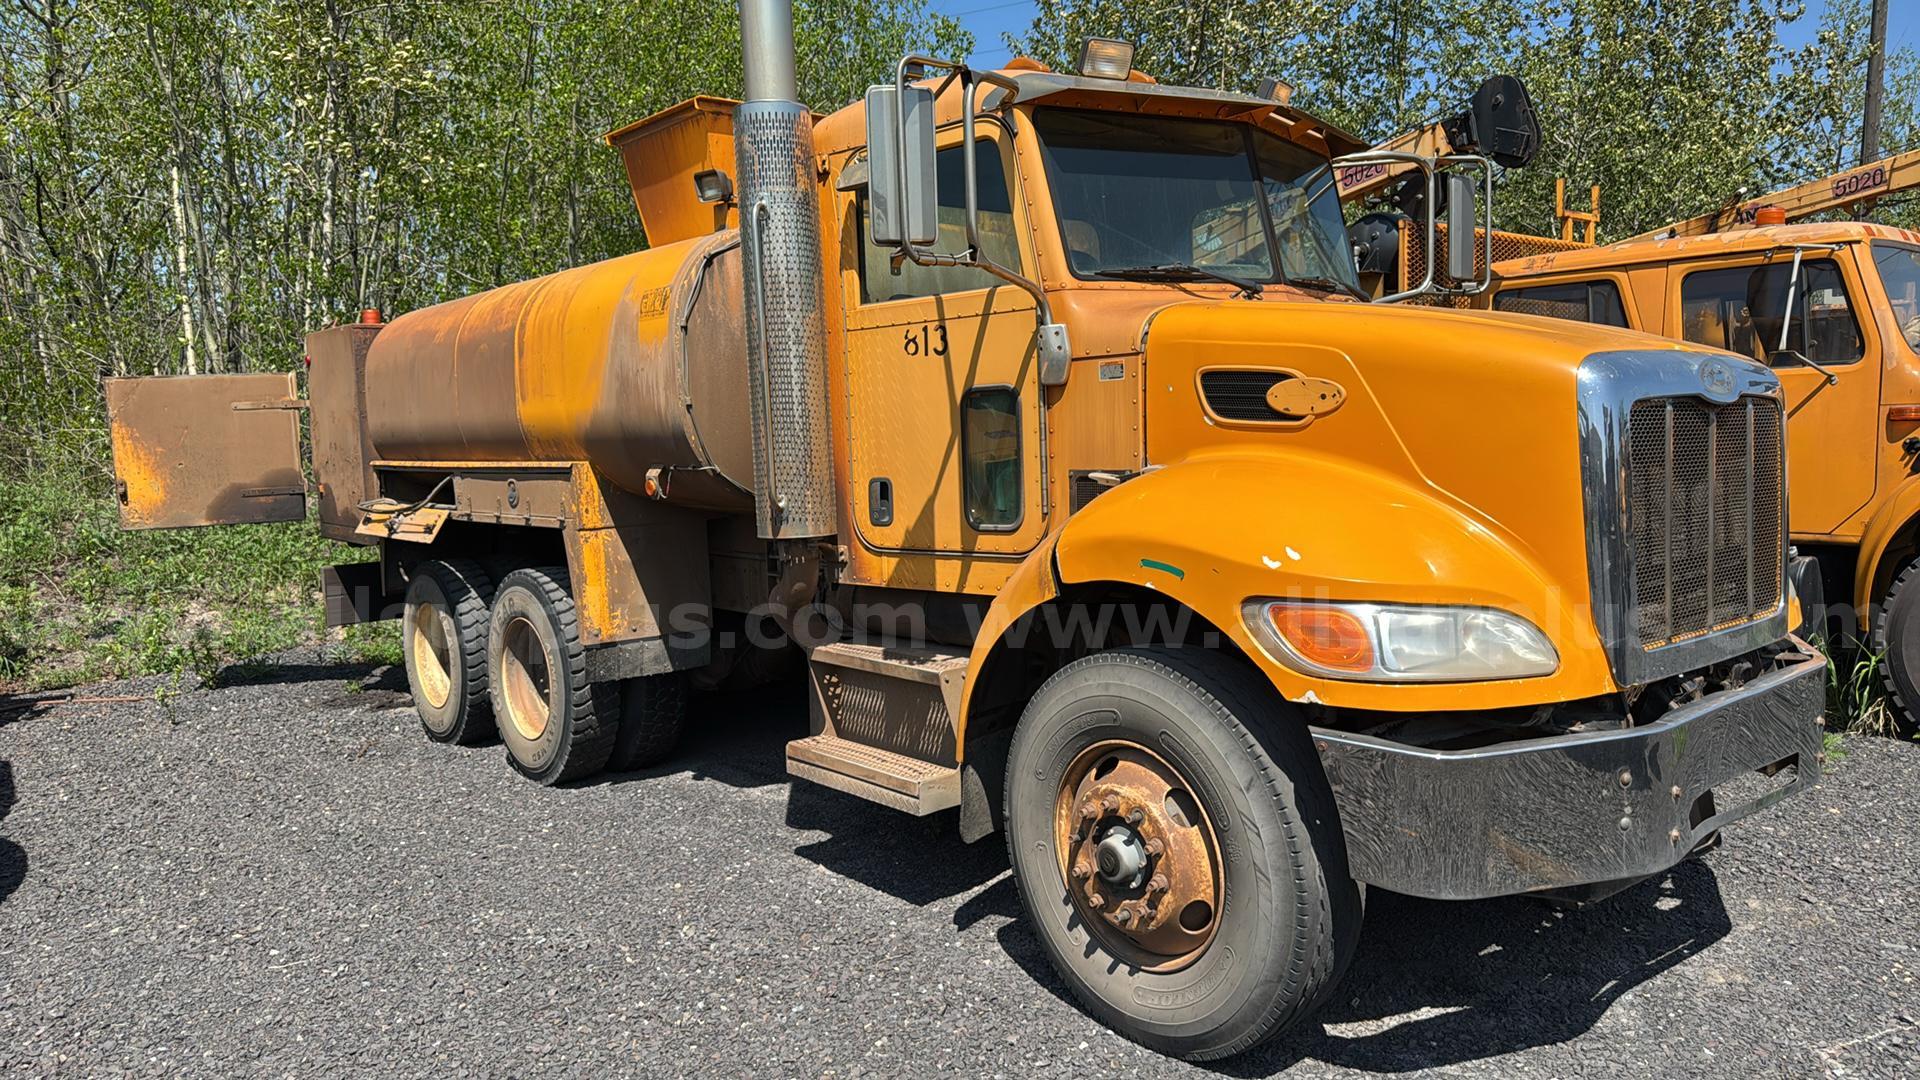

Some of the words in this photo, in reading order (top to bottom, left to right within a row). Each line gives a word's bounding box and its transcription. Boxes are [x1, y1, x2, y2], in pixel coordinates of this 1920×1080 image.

[1343, 163, 1384, 187] 5020
[1834, 168, 1884, 197] 5020
[903, 324, 949, 357] 813
